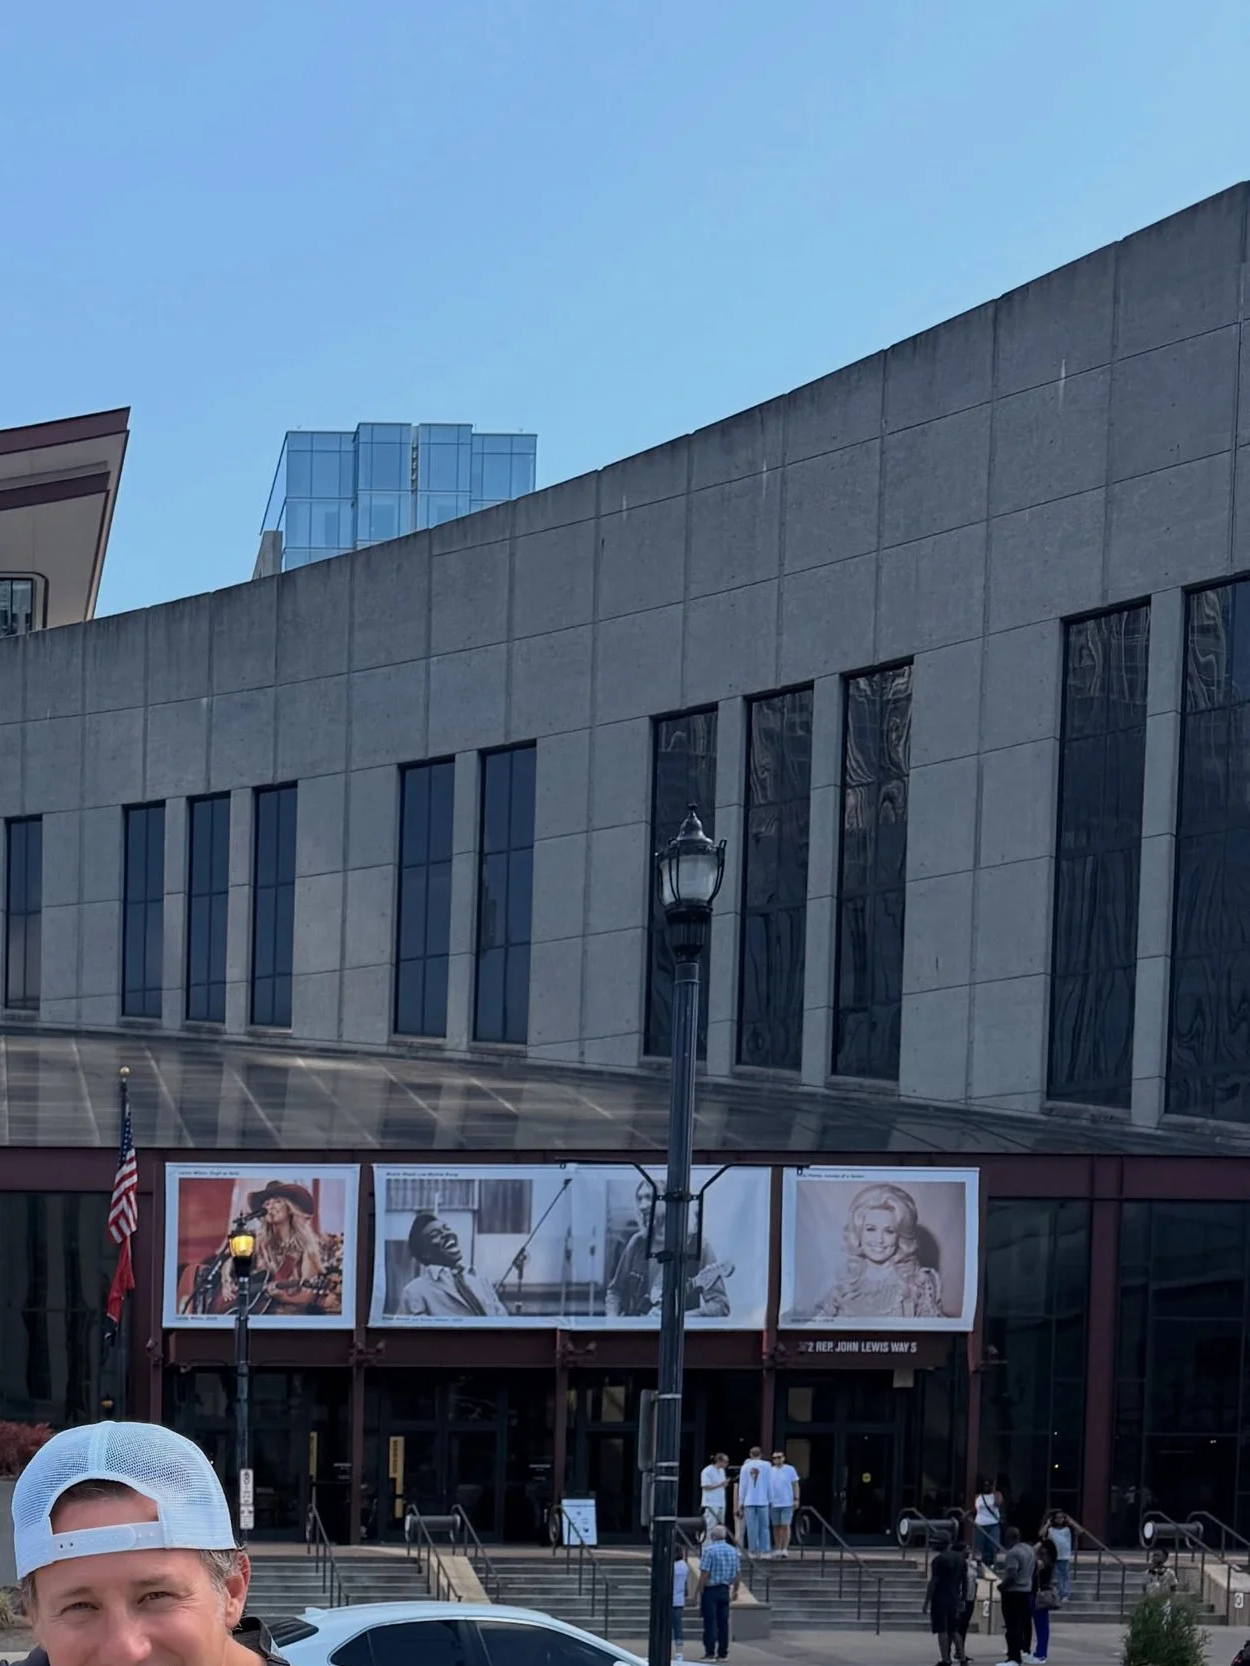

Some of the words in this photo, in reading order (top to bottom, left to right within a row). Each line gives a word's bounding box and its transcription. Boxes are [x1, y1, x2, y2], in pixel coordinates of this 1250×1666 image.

[835, 1341, 859, 1352] JOHN
[861, 1341, 889, 1352] LEWIS
[891, 1341, 910, 1352] WAY
